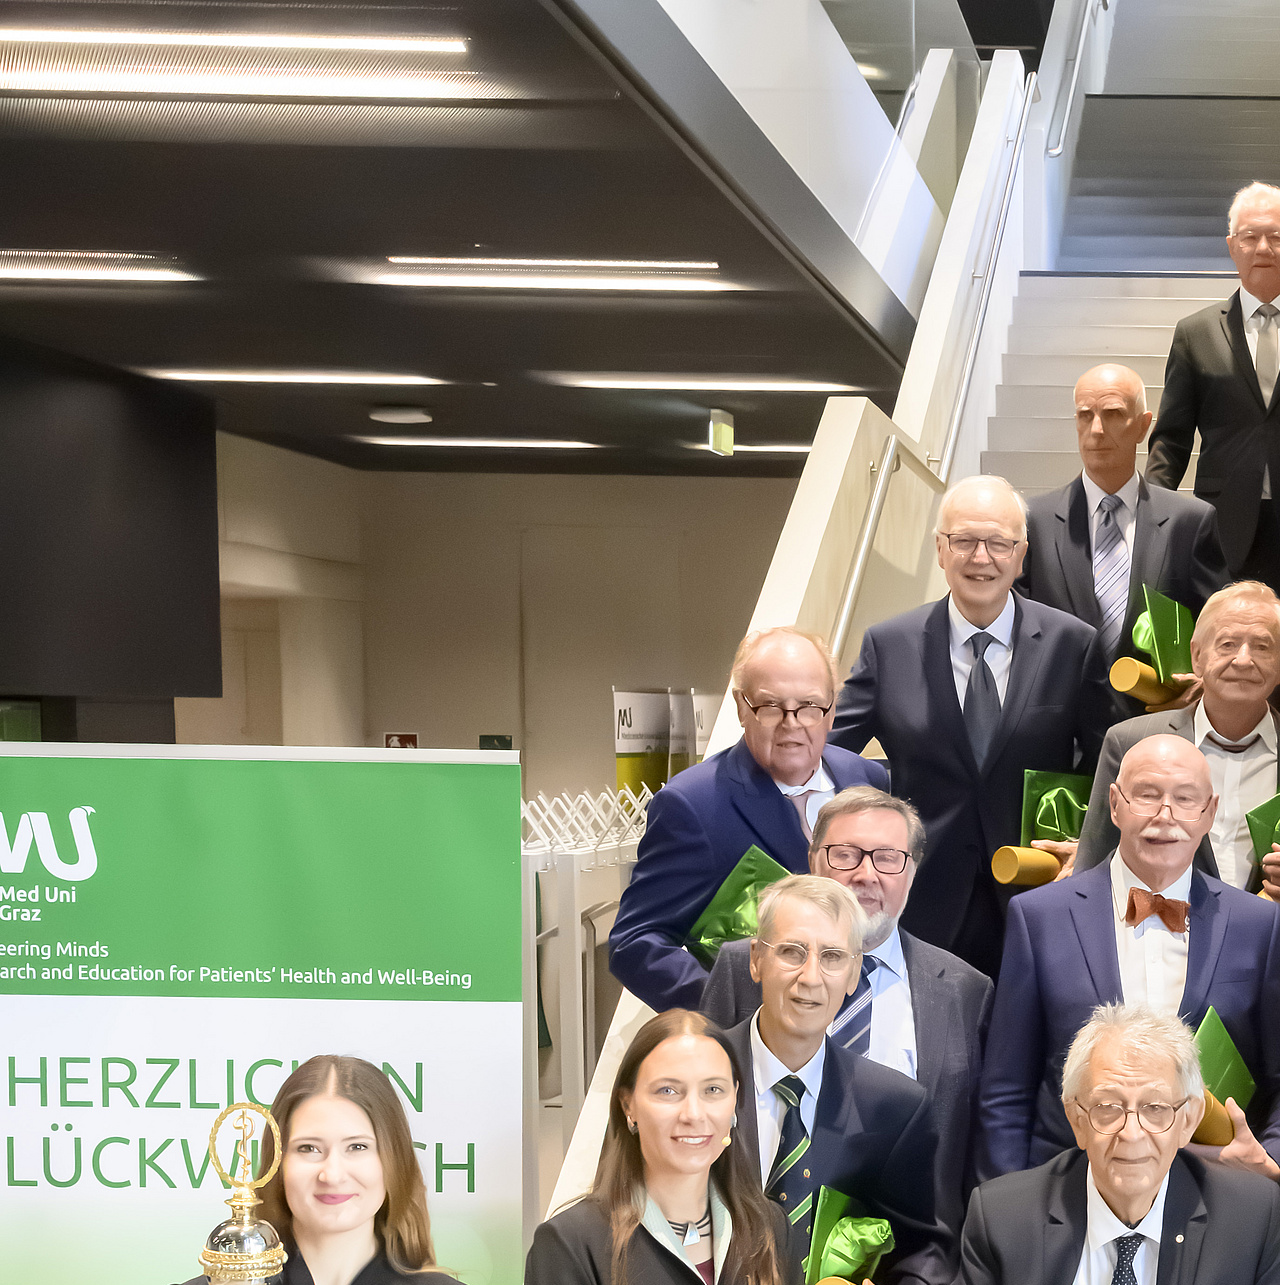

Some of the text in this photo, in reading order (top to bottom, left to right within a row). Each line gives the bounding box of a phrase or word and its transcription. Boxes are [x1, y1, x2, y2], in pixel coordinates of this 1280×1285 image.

[0, 885, 76, 902] Med Uni
[0, 905, 41, 921] Graz
[0, 941, 109, 960] eering Minds
[0, 963, 36, 980] arch
[41, 964, 73, 980] and
[78, 964, 165, 982] Education
[170, 965, 195, 982] for
[281, 967, 336, 984] Health
[341, 968, 373, 985] and
[378, 969, 472, 989] Well-Being
[8, 1056, 424, 1113] HERZLICN
[7, 1123, 476, 1193] LÜCKWH
